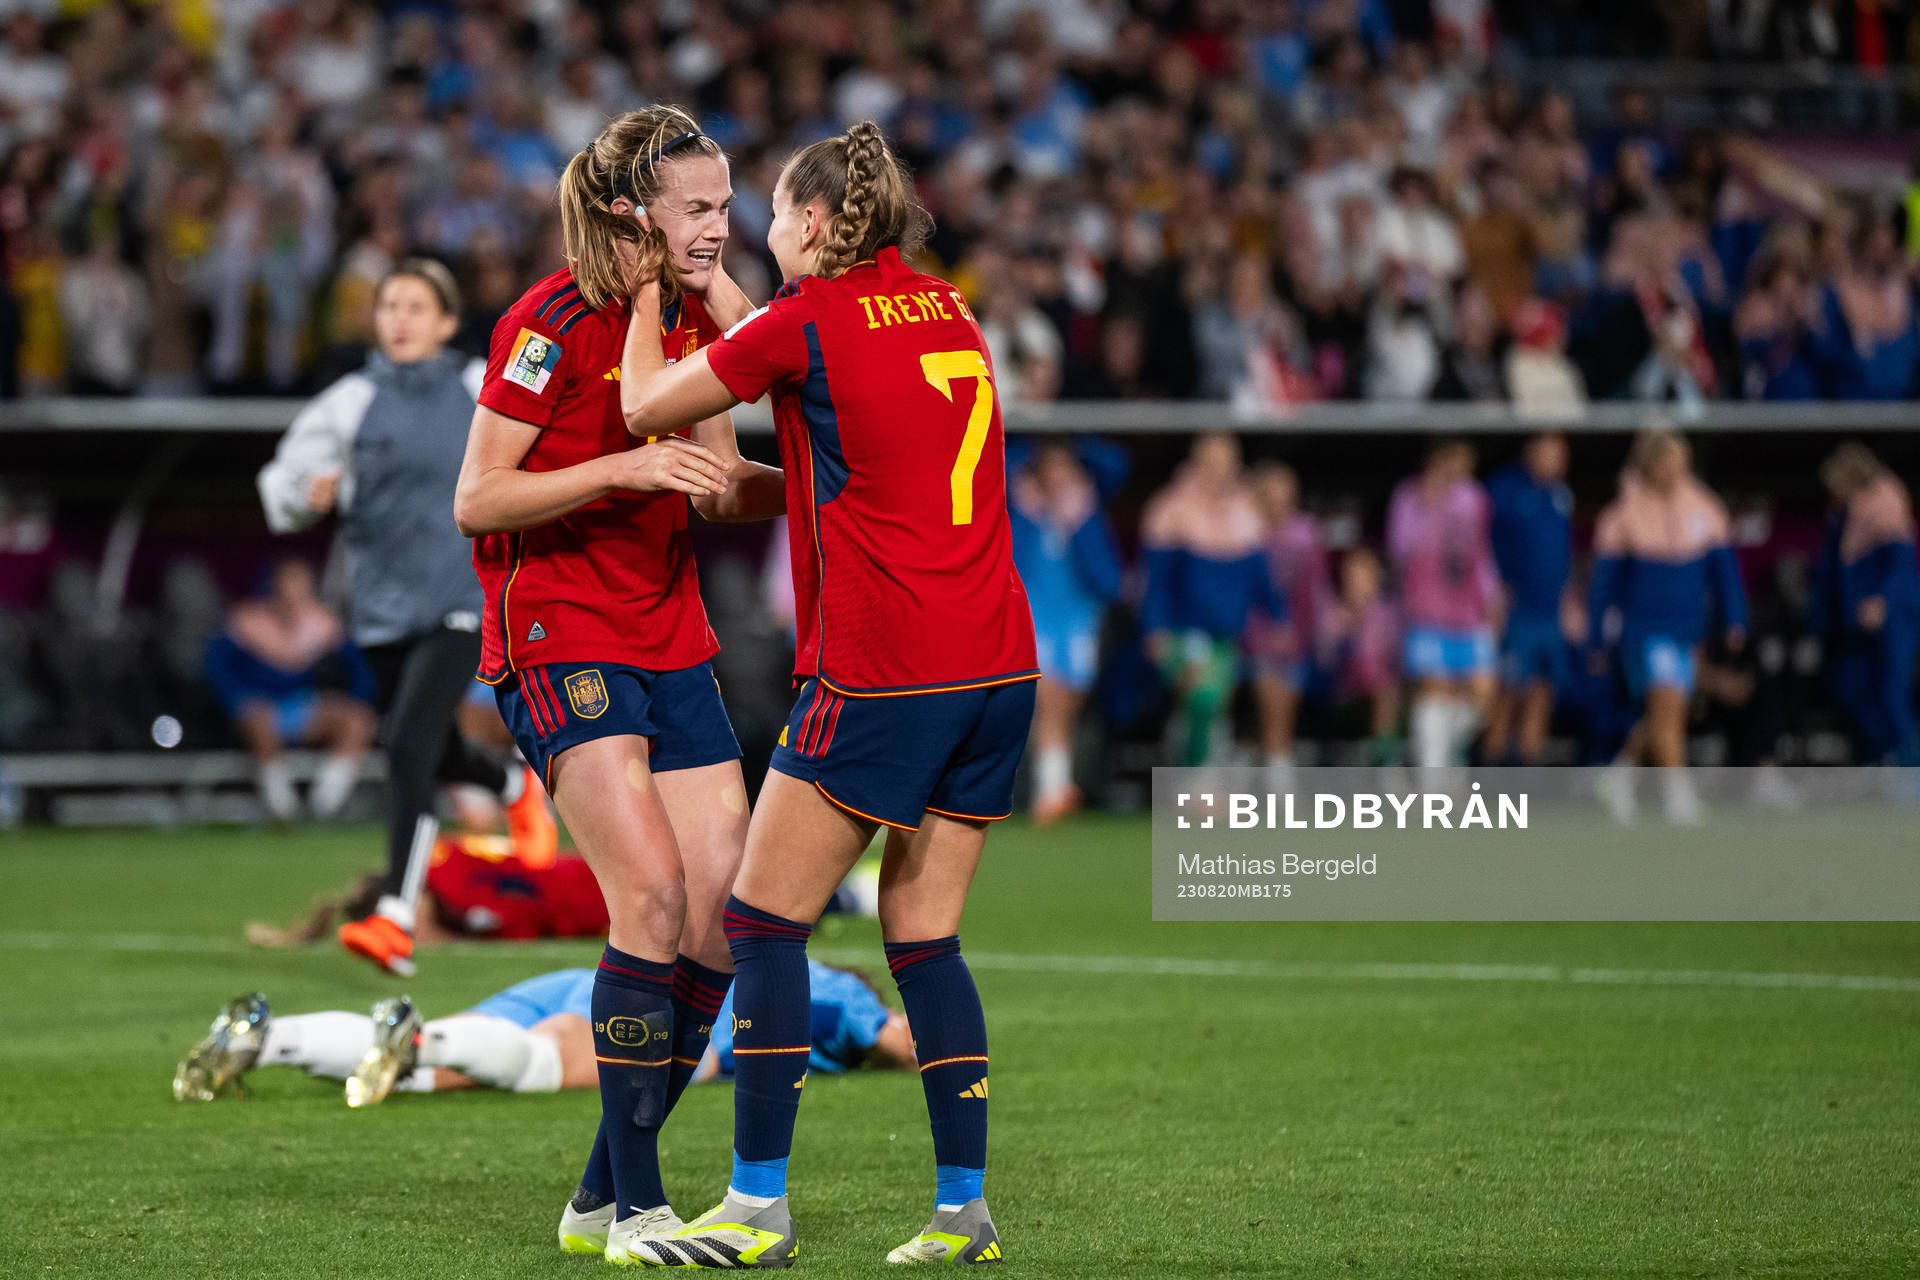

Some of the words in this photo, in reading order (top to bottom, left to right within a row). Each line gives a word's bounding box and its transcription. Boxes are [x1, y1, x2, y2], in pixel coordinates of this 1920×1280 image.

[858, 292, 952, 329] IRENE
[920, 350, 993, 525] 7
[595, 1022, 604, 1032] 19
[738, 1019, 752, 1029] 09
[654, 1031, 669, 1041] 09
